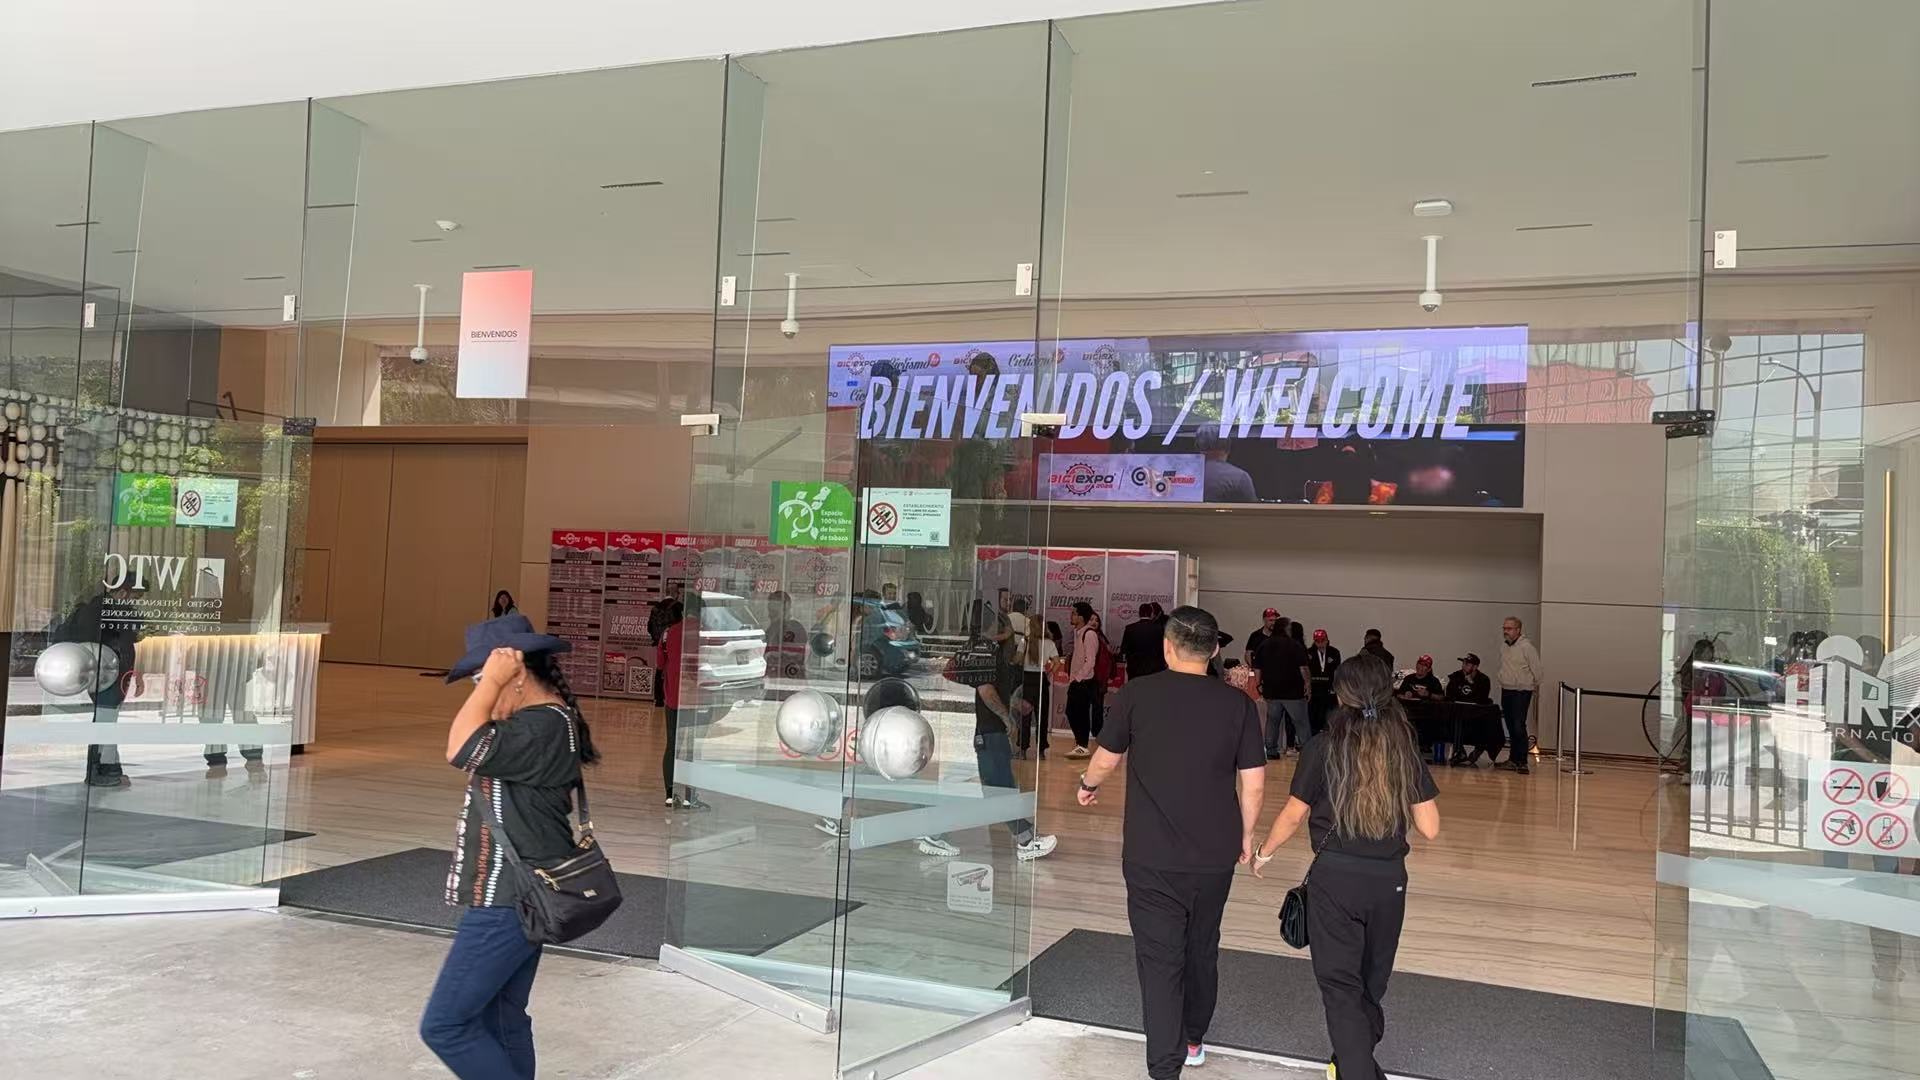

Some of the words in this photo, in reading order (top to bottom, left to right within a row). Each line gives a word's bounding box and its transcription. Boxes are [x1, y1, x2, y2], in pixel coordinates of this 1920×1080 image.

[471, 330, 518, 339] BIENVENIDOS
[860, 371, 1162, 440] BIENVENIDOS
[1218, 367, 1475, 439] WELCOME
[1048, 472, 1114, 484] BICIEXPO
[1046, 573, 1101, 581] BICIEXPO
[696, 578, 717, 591] $130
[757, 580, 778, 593] $130
[610, 624, 619, 634] DE
[1835, 727, 1915, 743] RNACIO
